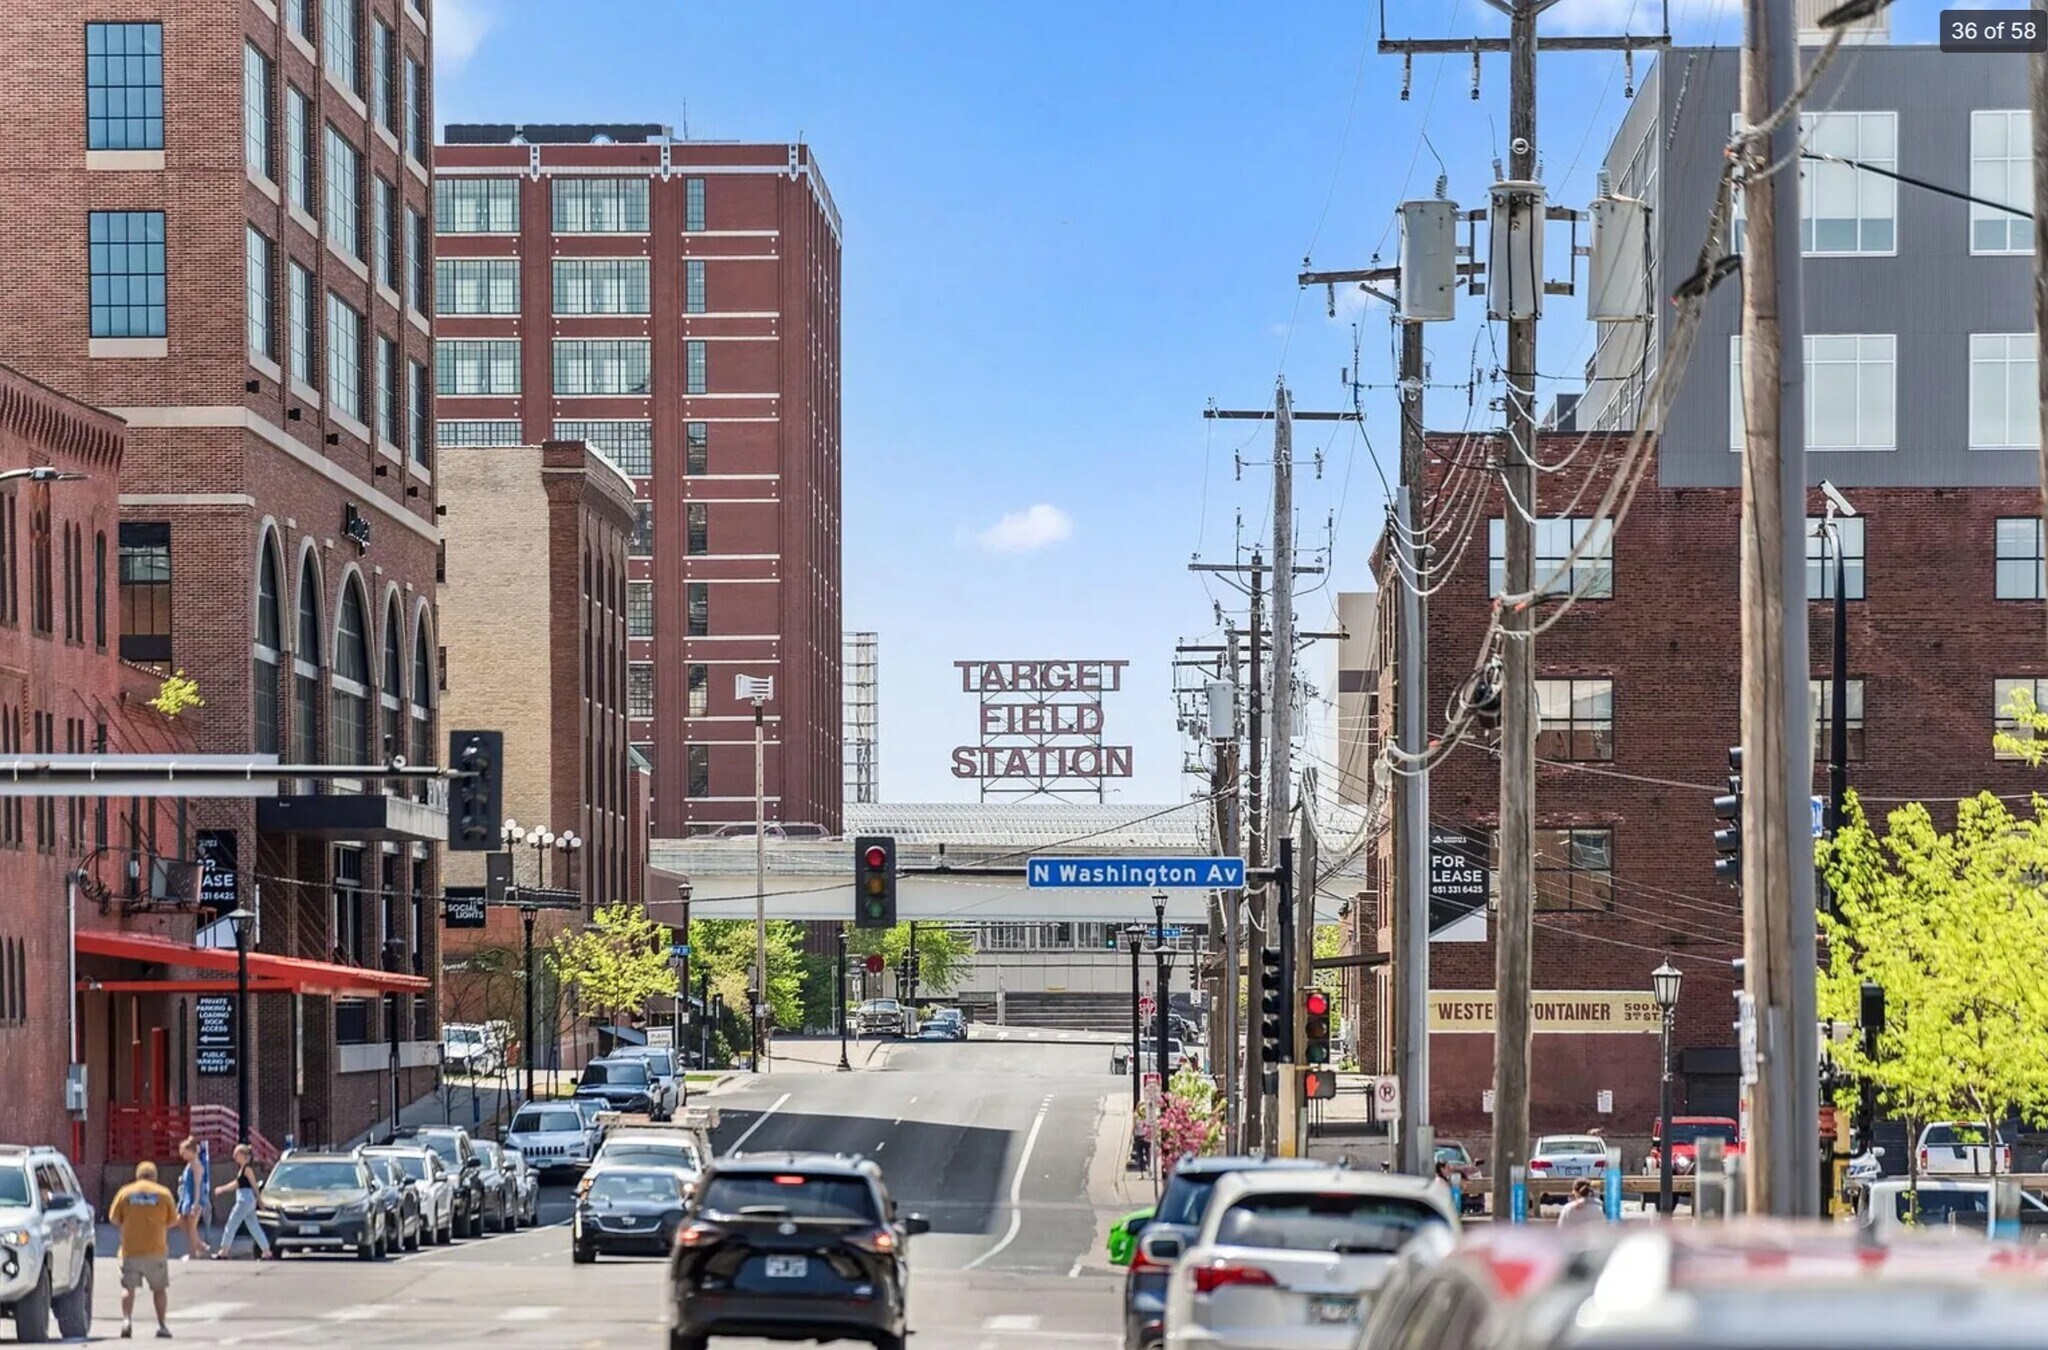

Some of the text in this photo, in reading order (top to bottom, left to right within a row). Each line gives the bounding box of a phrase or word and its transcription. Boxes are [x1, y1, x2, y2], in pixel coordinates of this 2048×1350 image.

[954, 660, 1130, 692] TARGET
[980, 703, 1105, 735] FIELD
[951, 746, 1133, 778] STATION
[1432, 855, 1465, 868] FOR
[202, 874, 234, 887] ASE
[1034, 864, 1238, 887] N Washington Av
[1432, 870, 1482, 882] LEASE
[1432, 885, 1483, 893] 651 331 6425
[447, 903, 479, 912] SOCIAL
[455, 911, 484, 919] LIGHTS
[1438, 1003, 1611, 1020] WESTE ONTAINER
[1624, 1003, 1650, 1011] 500
